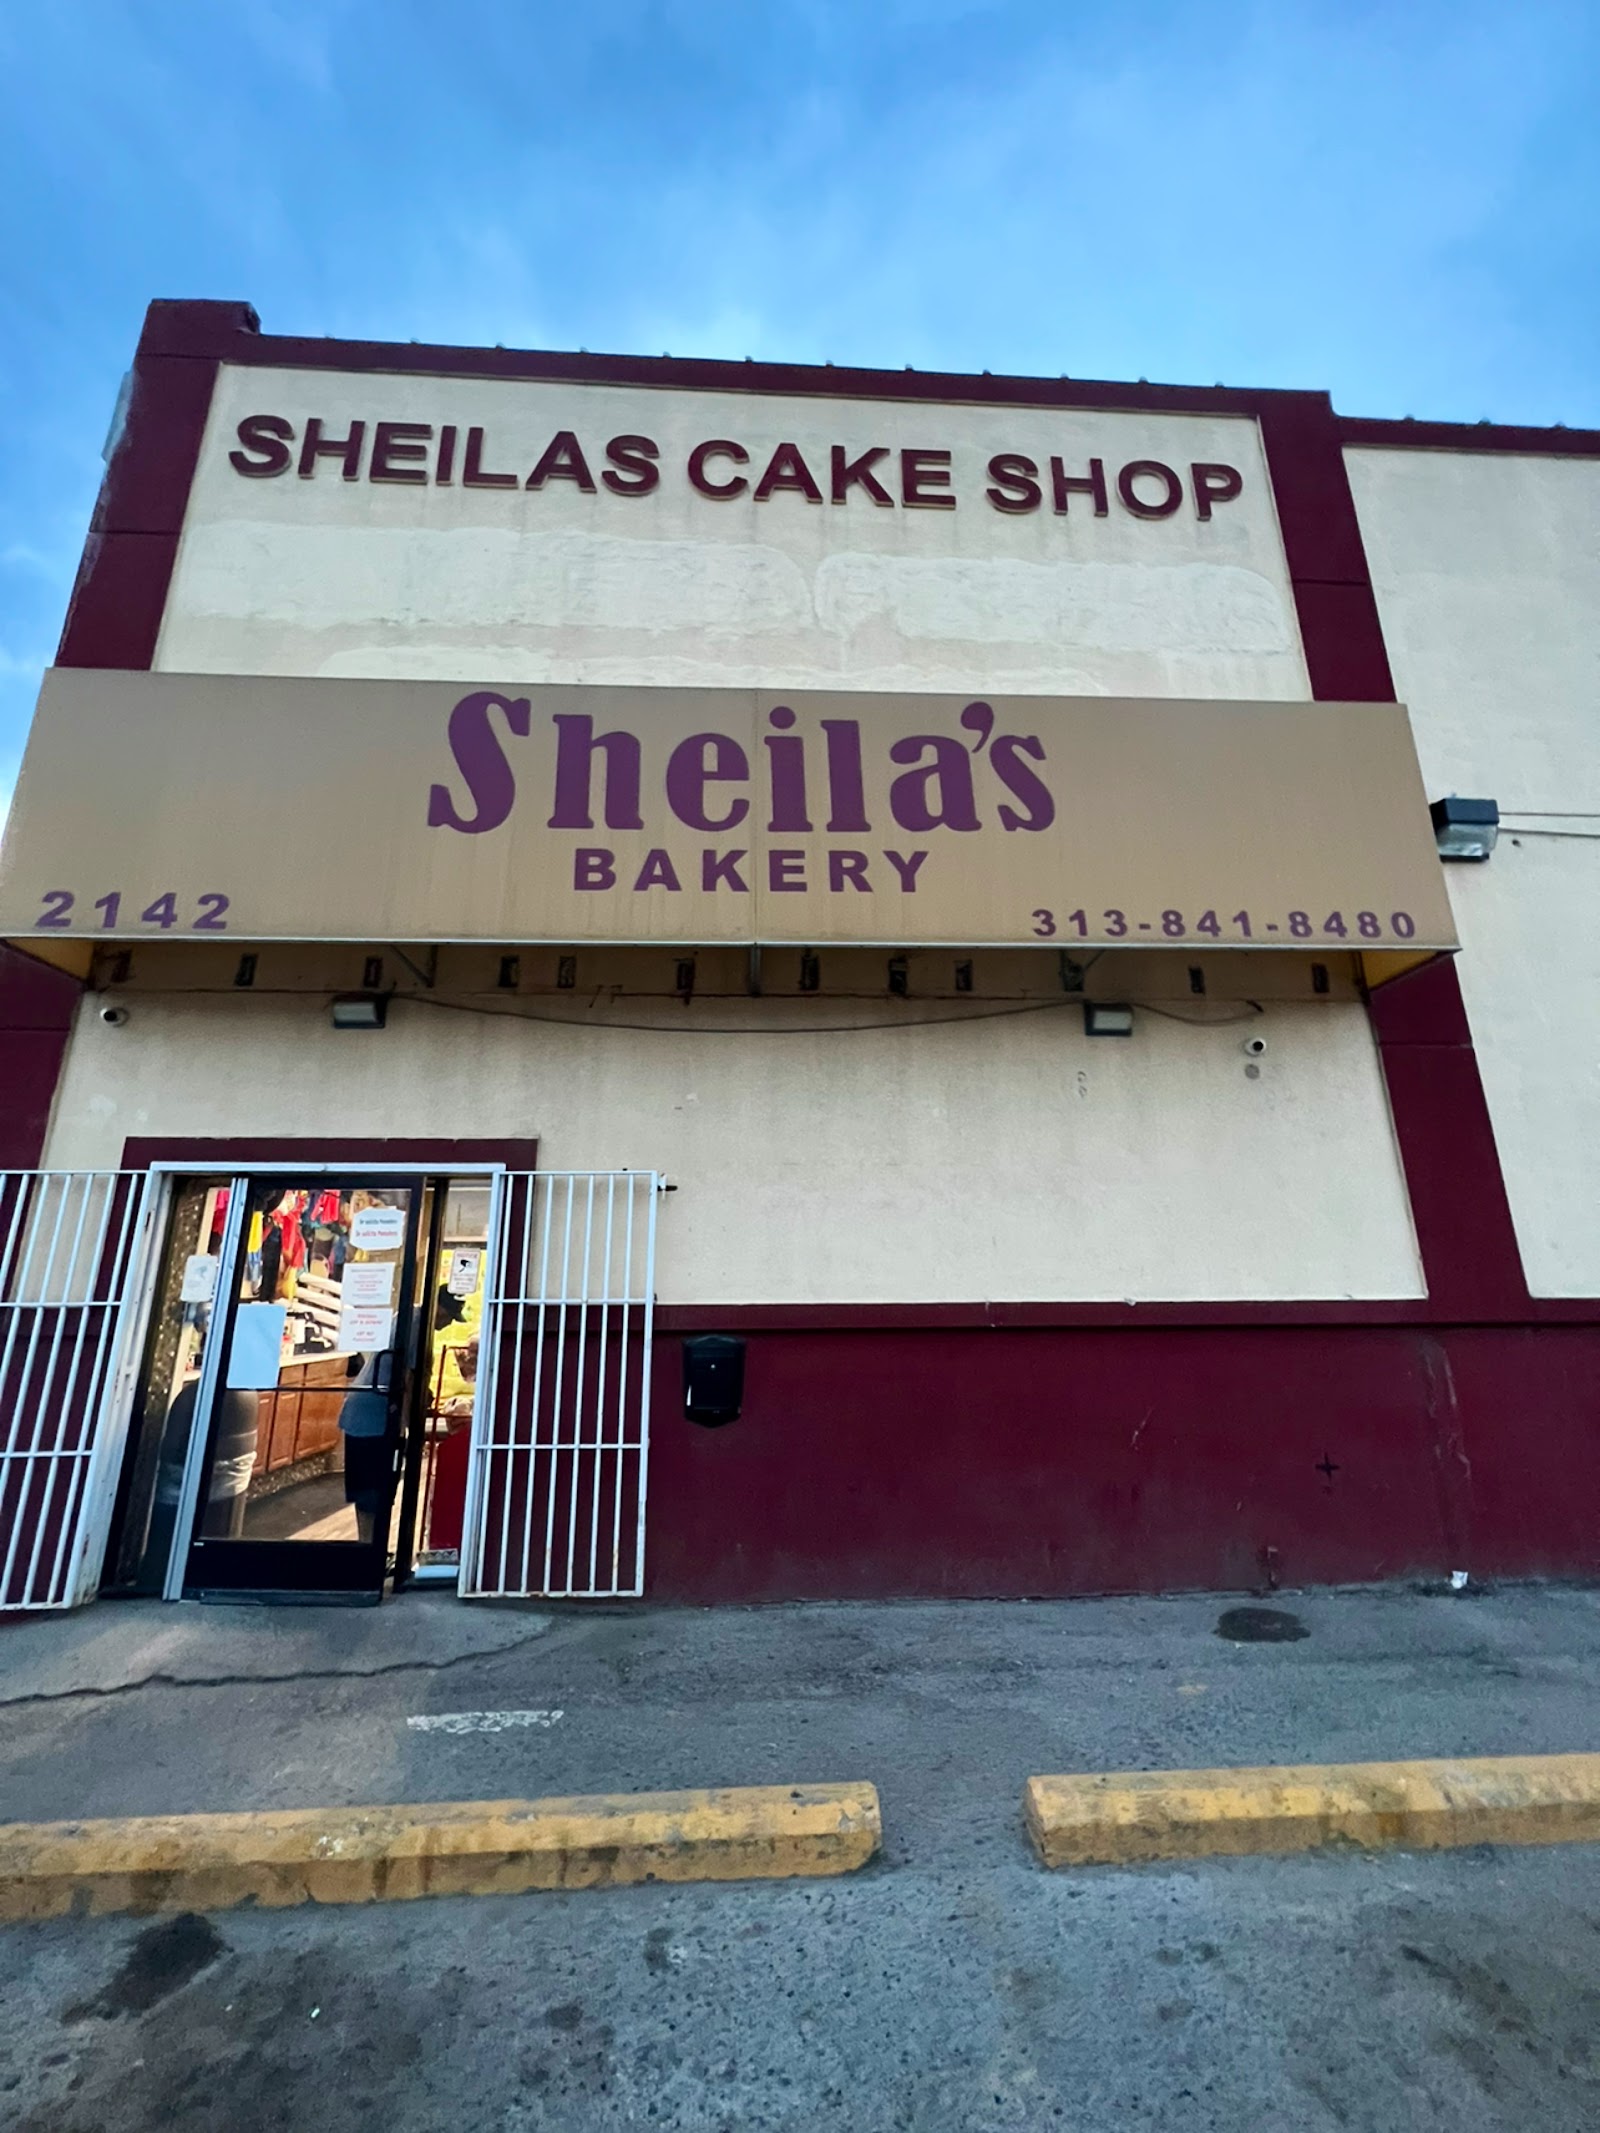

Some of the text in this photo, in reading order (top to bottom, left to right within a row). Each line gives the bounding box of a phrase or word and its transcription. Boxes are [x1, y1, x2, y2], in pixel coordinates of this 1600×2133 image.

[229, 414, 1243, 524] SHEILAS CAKE SHOP
[429, 691, 1055, 833] Sheila's
[575, 849, 926, 893] BAKERY
[35, 890, 231, 930] 2142
[1032, 908, 1418, 939] 313-841-8480
